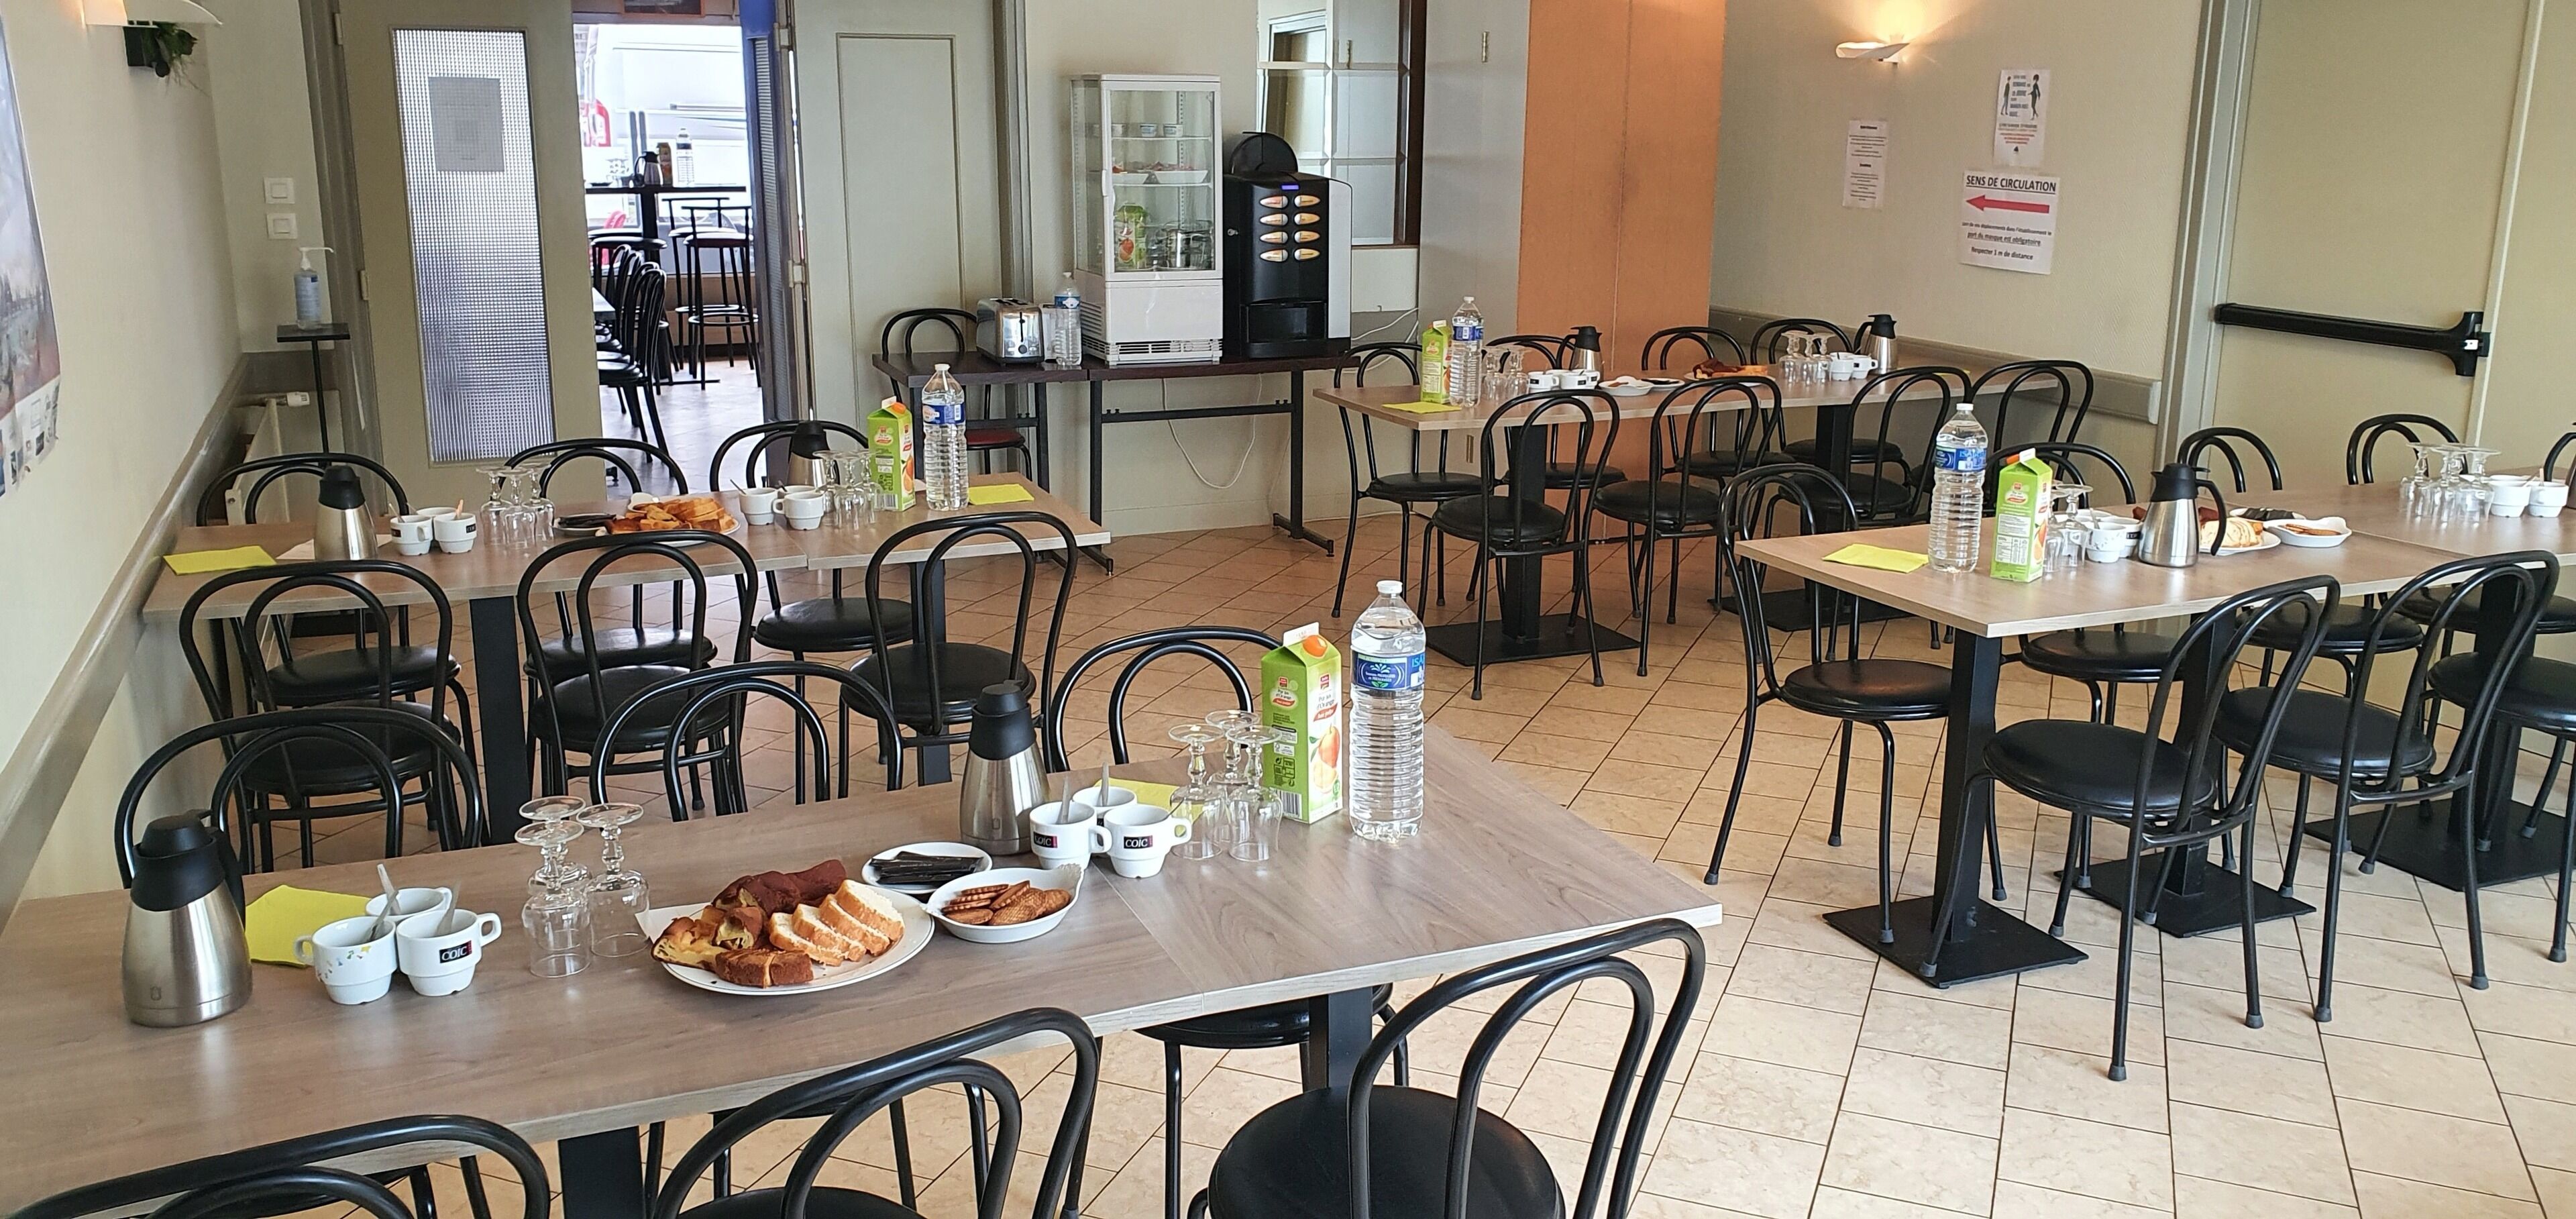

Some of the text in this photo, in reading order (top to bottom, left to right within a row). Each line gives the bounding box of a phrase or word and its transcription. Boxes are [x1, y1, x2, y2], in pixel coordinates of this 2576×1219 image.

[1966, 175, 2056, 192] SENS DE CIRCULATION
[1984, 233, 2002, 242] masque
[2012, 237, 2041, 246] obligatoire
[1971, 246, 1993, 255] Respecter
[2011, 252, 2033, 260] distance
